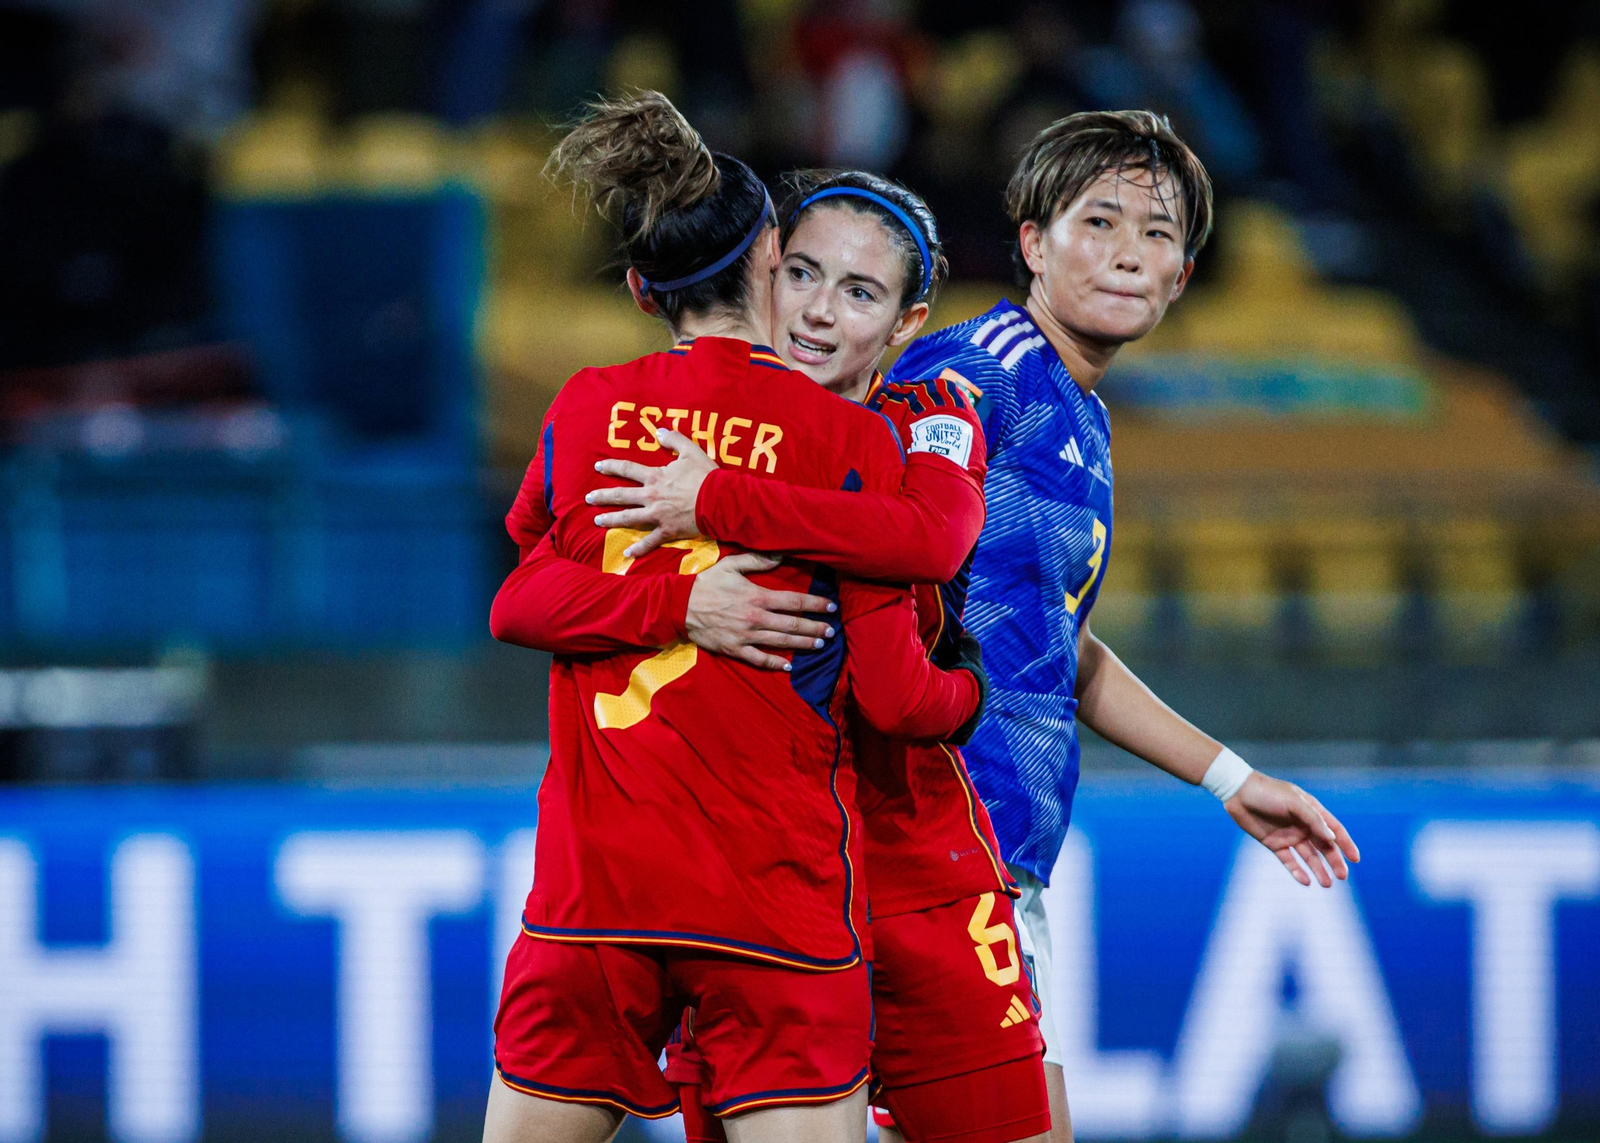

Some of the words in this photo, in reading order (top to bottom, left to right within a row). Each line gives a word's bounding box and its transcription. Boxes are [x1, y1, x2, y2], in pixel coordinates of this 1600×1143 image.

[607, 401, 783, 474] ESTHER
[925, 422, 962, 434] FOOTBALL
[925, 430, 962, 443] UNITES
[1055, 518, 1106, 615] 3
[967, 891, 1020, 987] 6
